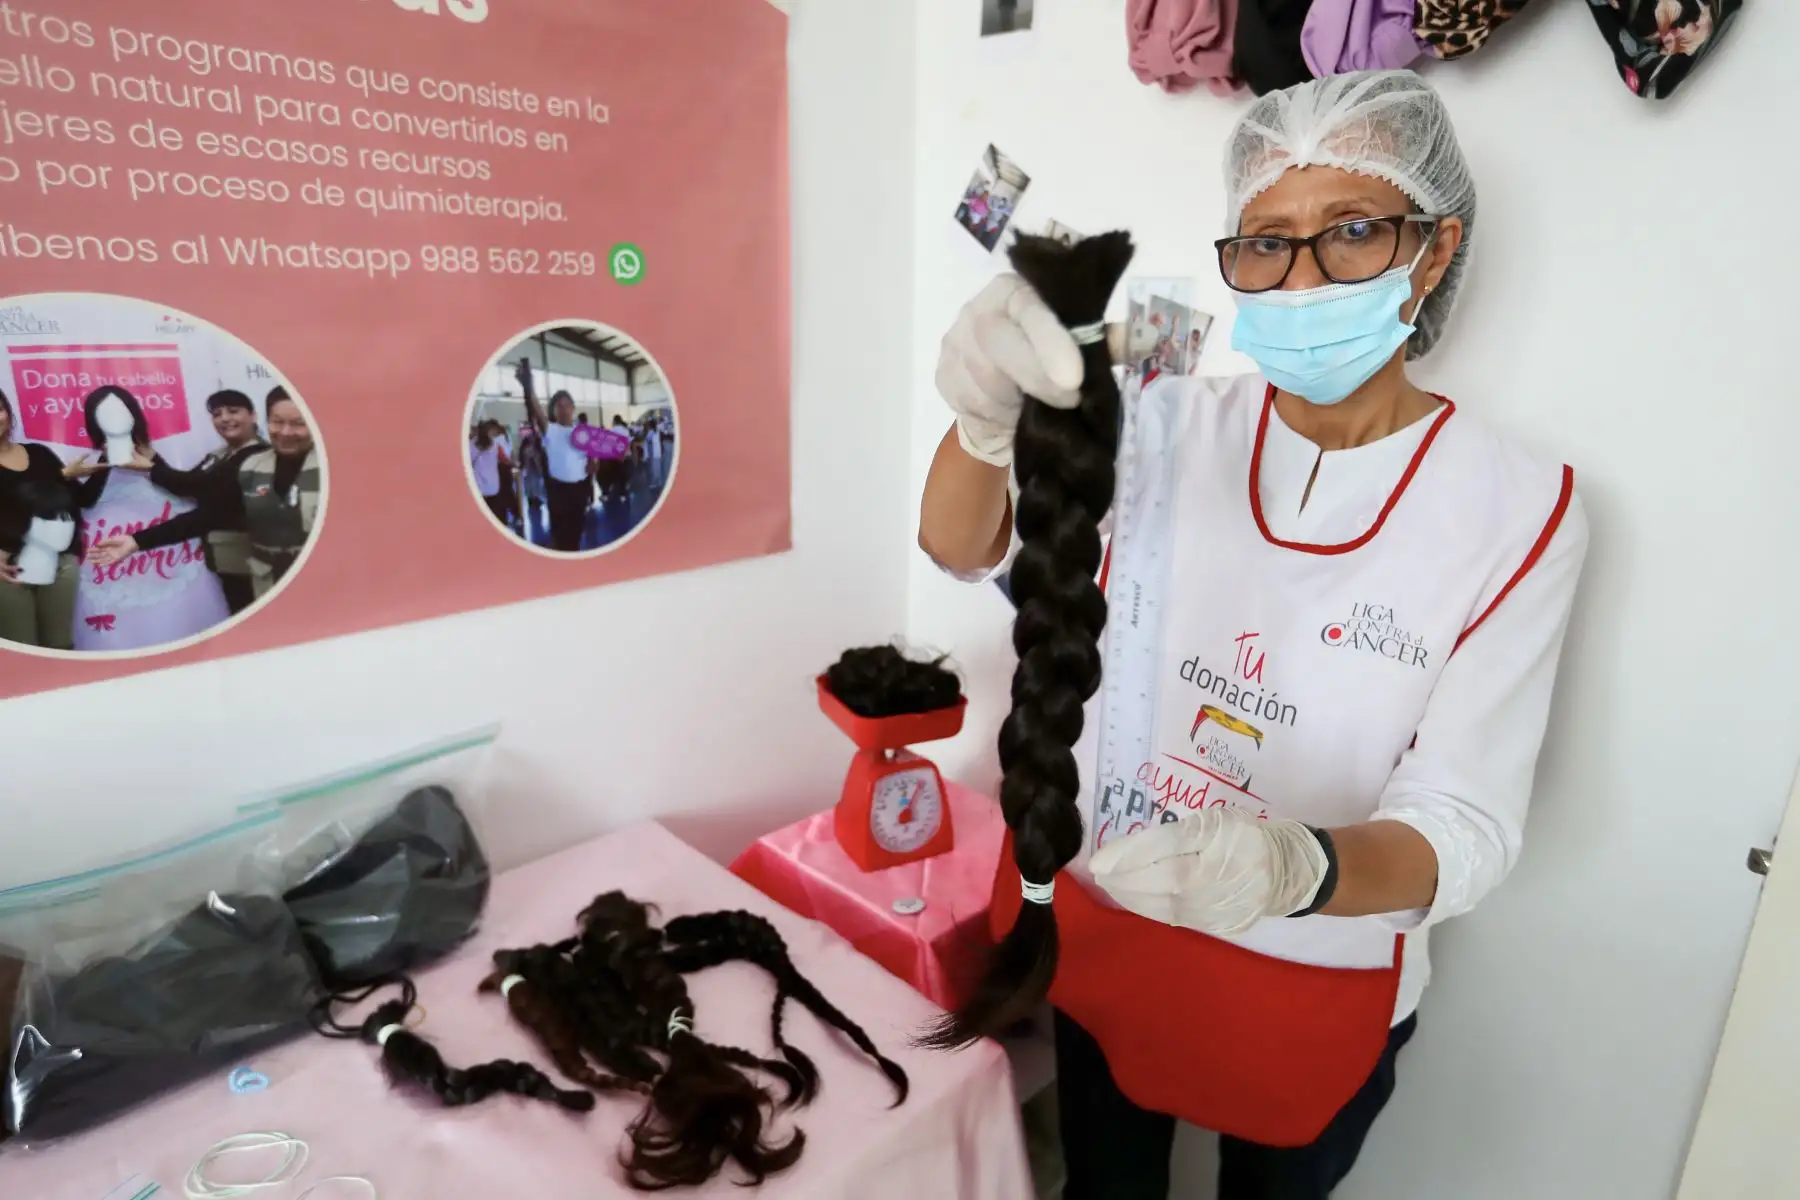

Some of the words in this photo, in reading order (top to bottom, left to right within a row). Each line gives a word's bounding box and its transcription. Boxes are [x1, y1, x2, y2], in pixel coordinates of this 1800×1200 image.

[0, 1, 96, 48] tros
[108, 25, 336, 85] programas
[345, 64, 410, 99] que
[418, 76, 540, 114] consiste
[545, 95, 581, 120] en
[586, 96, 611, 125] la
[0, 53, 76, 93] ello
[89, 71, 242, 115] natural
[253, 94, 341, 127] para
[350, 107, 528, 152] convertirlos
[533, 130, 569, 153] en
[128, 117, 184, 152] de
[195, 131, 349, 168] escasos
[358, 148, 492, 181] recursos
[35, 159, 113, 195] por
[127, 167, 291, 204] proceso
[299, 177, 345, 207] de
[354, 186, 568, 227] quimioterapia.
[170, 233, 210, 265] al
[218, 235, 412, 280] Whatsapp
[419, 243, 481, 274] 988
[487, 247, 541, 275] 562
[547, 249, 596, 277] 259
[22, 369, 92, 389] Dona
[117, 371, 177, 386] cabello
[28, 403, 38, 418] y
[1346, 617, 1411, 644] CONTRA
[1351, 602, 1394, 624] LIGA
[1233, 629, 1265, 685] Tu
[1179, 655, 1298, 727] donación
